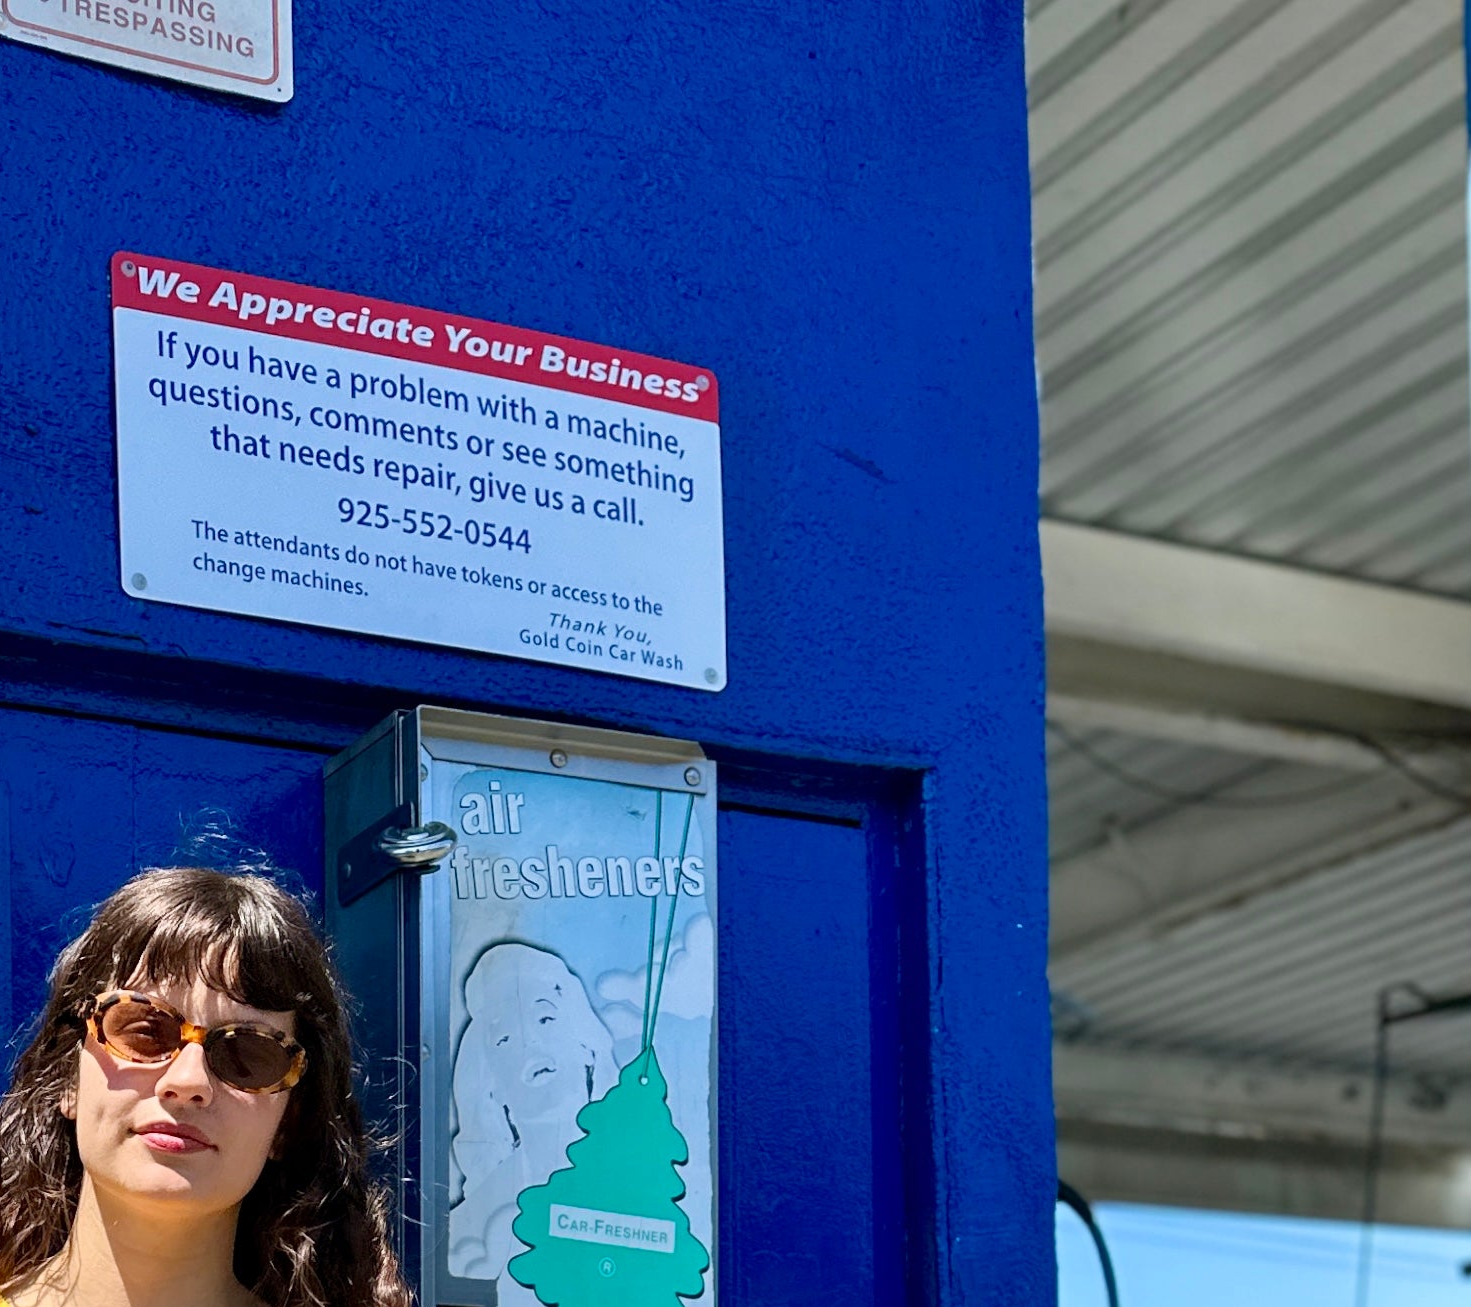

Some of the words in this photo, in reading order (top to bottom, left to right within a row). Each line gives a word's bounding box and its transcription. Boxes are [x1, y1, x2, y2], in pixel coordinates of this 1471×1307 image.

[137, 266, 200, 303] We
[208, 281, 435, 348] Appreciate
[444, 323, 533, 366] Your
[539, 344, 700, 403] Business
[157, 329, 178, 360] If
[184, 340, 239, 371] you
[248, 345, 318, 385] have
[326, 367, 341, 390] a
[350, 371, 469, 413] problem
[476, 393, 536, 426] with
[544, 409, 559, 430] a
[567, 412, 686, 459] machine,
[148, 376, 302, 427] questions,
[309, 404, 458, 451] comments
[465, 433, 495, 458] or
[502, 440, 547, 468] see
[554, 450, 695, 503] something
[210, 424, 271, 460] that
[279, 441, 366, 475] needs
[373, 457, 461, 497] repair,
[468, 471, 527, 503] give
[534, 486, 564, 511] us
[571, 493, 586, 515] a
[593, 496, 645, 527] call.
[337, 496, 532, 555] 925-552-0544
[190, 518, 229, 544] The
[233, 529, 340, 561] attendants
[344, 545, 370, 566] do
[374, 553, 408, 574] not
[411, 554, 457, 582] have
[461, 565, 523, 592] tokens
[527, 579, 547, 596] or
[551, 583, 607, 607] access
[612, 591, 630, 611] to
[634, 594, 663, 617] the
[192, 551, 266, 583] change
[270, 566, 370, 598] machines.
[519, 628, 560, 650] Gold
[565, 636, 603, 657] Coin
[608, 643, 637, 663] Car
[640, 649, 684, 672] Wash
[548, 612, 607, 637] Thank
[614, 623, 652, 647] You,
[459, 780, 525, 837] air
[450, 843, 706, 902] fresheners
